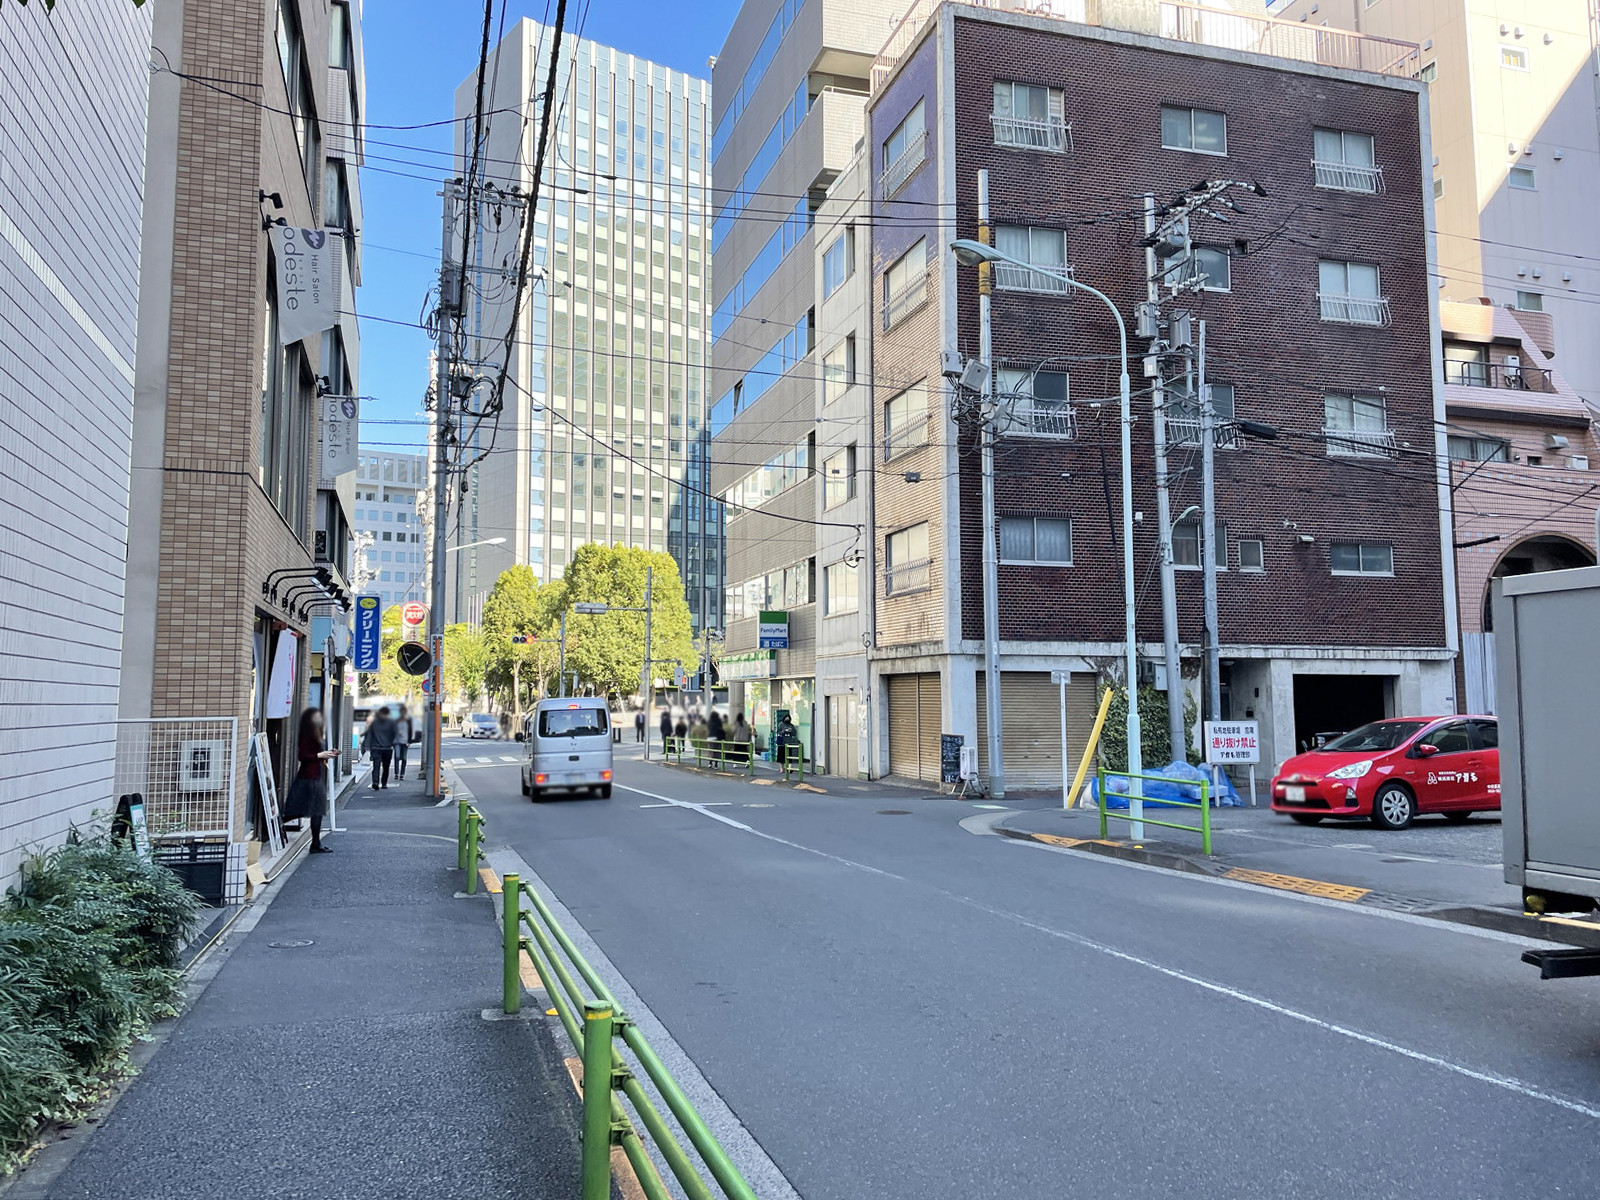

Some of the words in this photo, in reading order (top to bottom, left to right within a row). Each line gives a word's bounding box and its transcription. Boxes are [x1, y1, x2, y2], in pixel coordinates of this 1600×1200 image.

[312, 278, 320, 304] Salon
[360, 609, 375, 669] クリーニング
[1212, 737, 1257, 748] 通り抜け禁止
